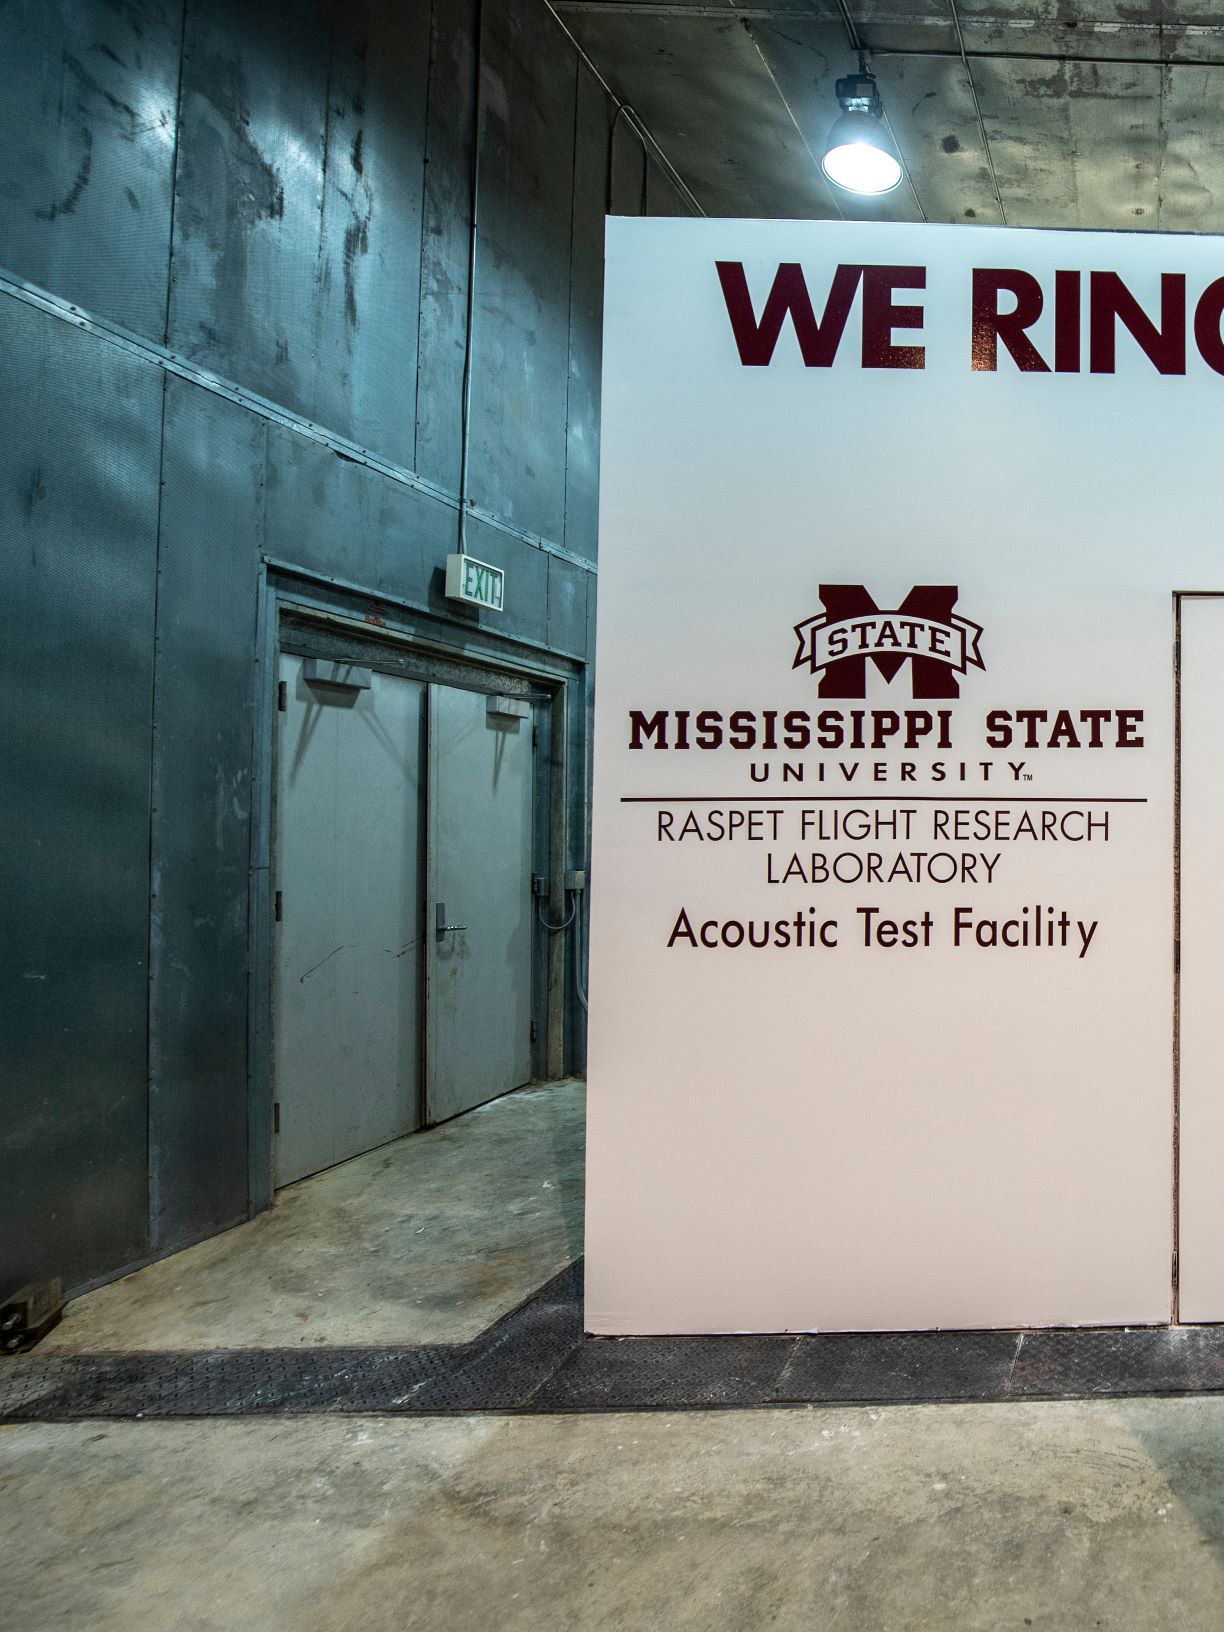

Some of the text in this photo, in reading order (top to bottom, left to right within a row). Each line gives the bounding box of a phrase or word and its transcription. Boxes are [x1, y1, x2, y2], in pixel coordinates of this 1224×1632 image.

[715, 260, 926, 369] WE
[465, 563, 498, 604] EXIT
[828, 621, 951, 657] STATE
[629, 710, 1144, 749] MISSISSIPPI STATE
[658, 810, 1109, 841] RASPET FLIGHT RESEARCH
[767, 852, 1002, 883] LABORATORY
[667, 905, 1099, 958] Acoustic Test Facility
